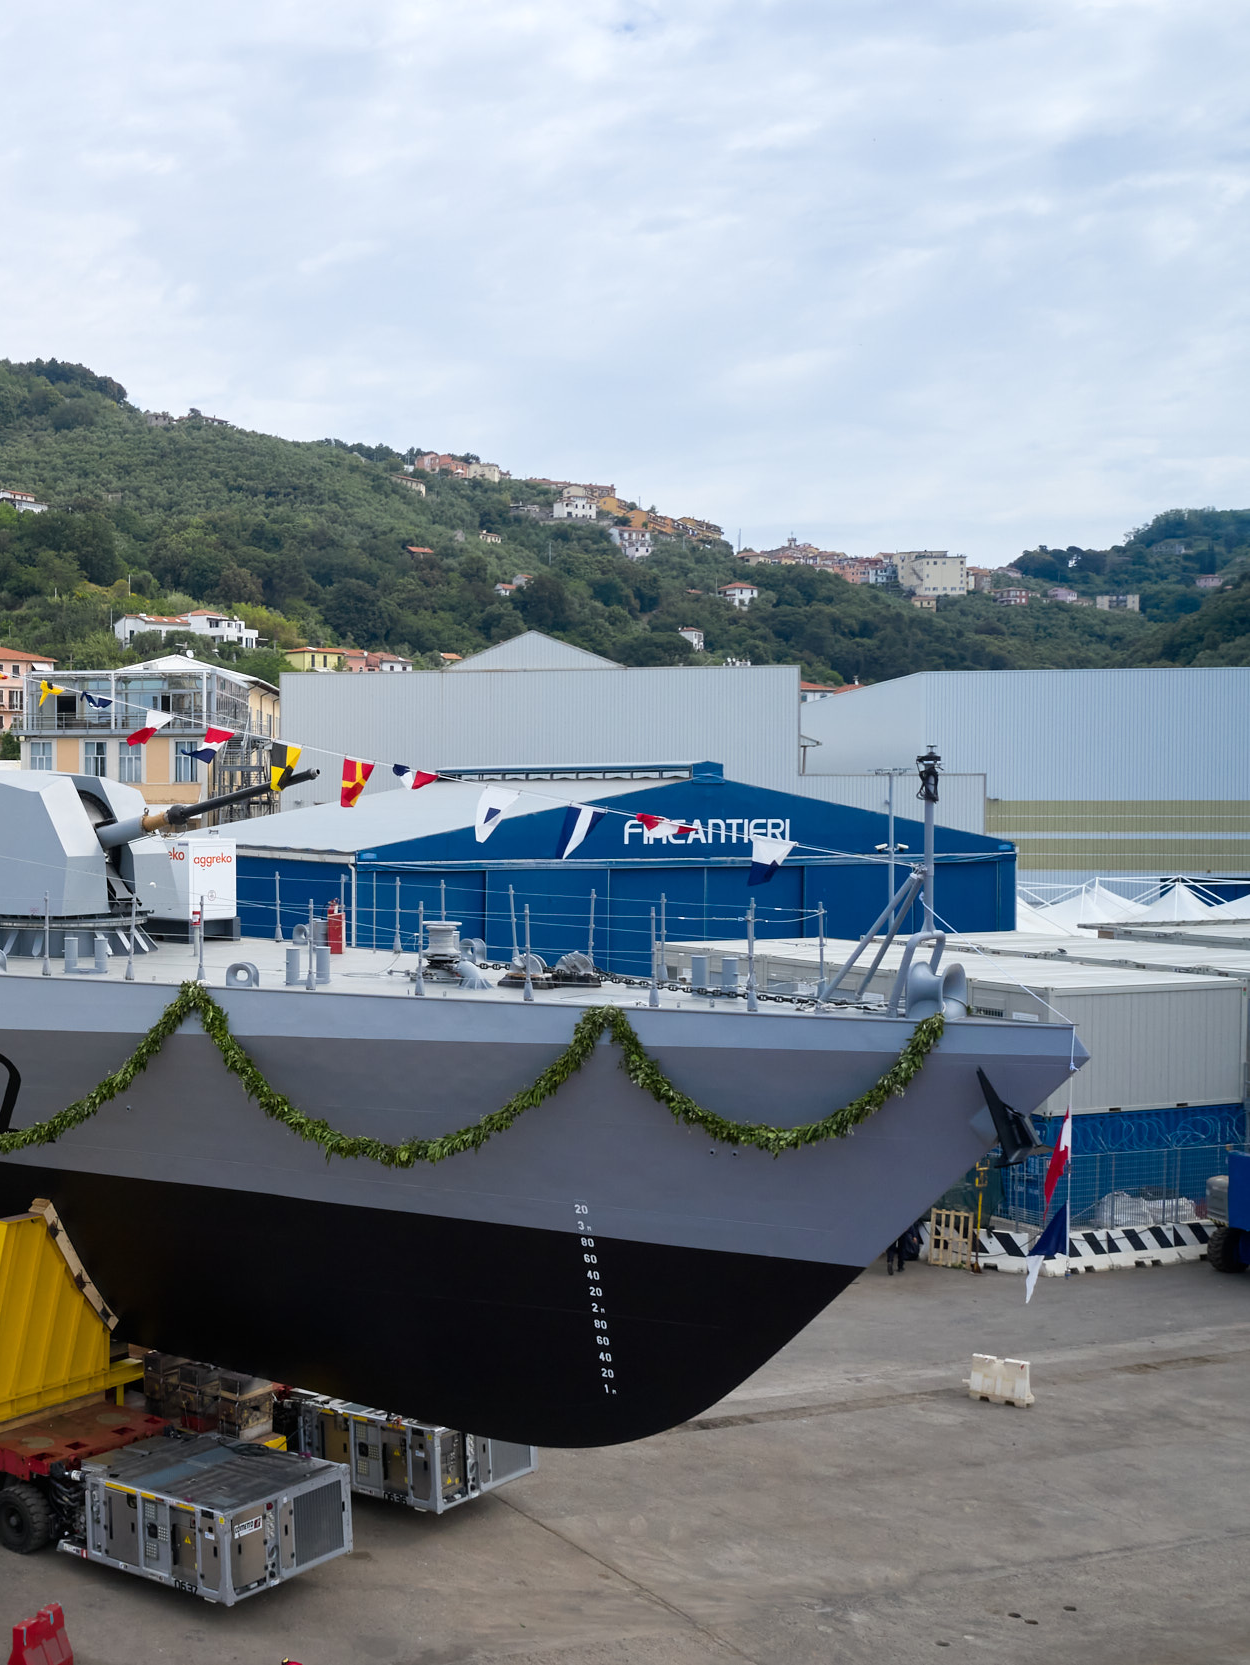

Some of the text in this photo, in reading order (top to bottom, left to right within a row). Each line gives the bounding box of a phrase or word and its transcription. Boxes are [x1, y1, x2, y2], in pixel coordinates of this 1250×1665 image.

[193, 852, 232, 868] aggreko
[574, 1203, 588, 1214] 20
[580, 1237, 595, 1248] 80
[583, 1253, 598, 1264] 60
[586, 1270, 600, 1281] 40
[589, 1286, 603, 1297] 20
[593, 1319, 608, 1330] 80
[596, 1335, 610, 1346] 60
[599, 1351, 612, 1362] 40
[601, 1367, 614, 1378] 20
